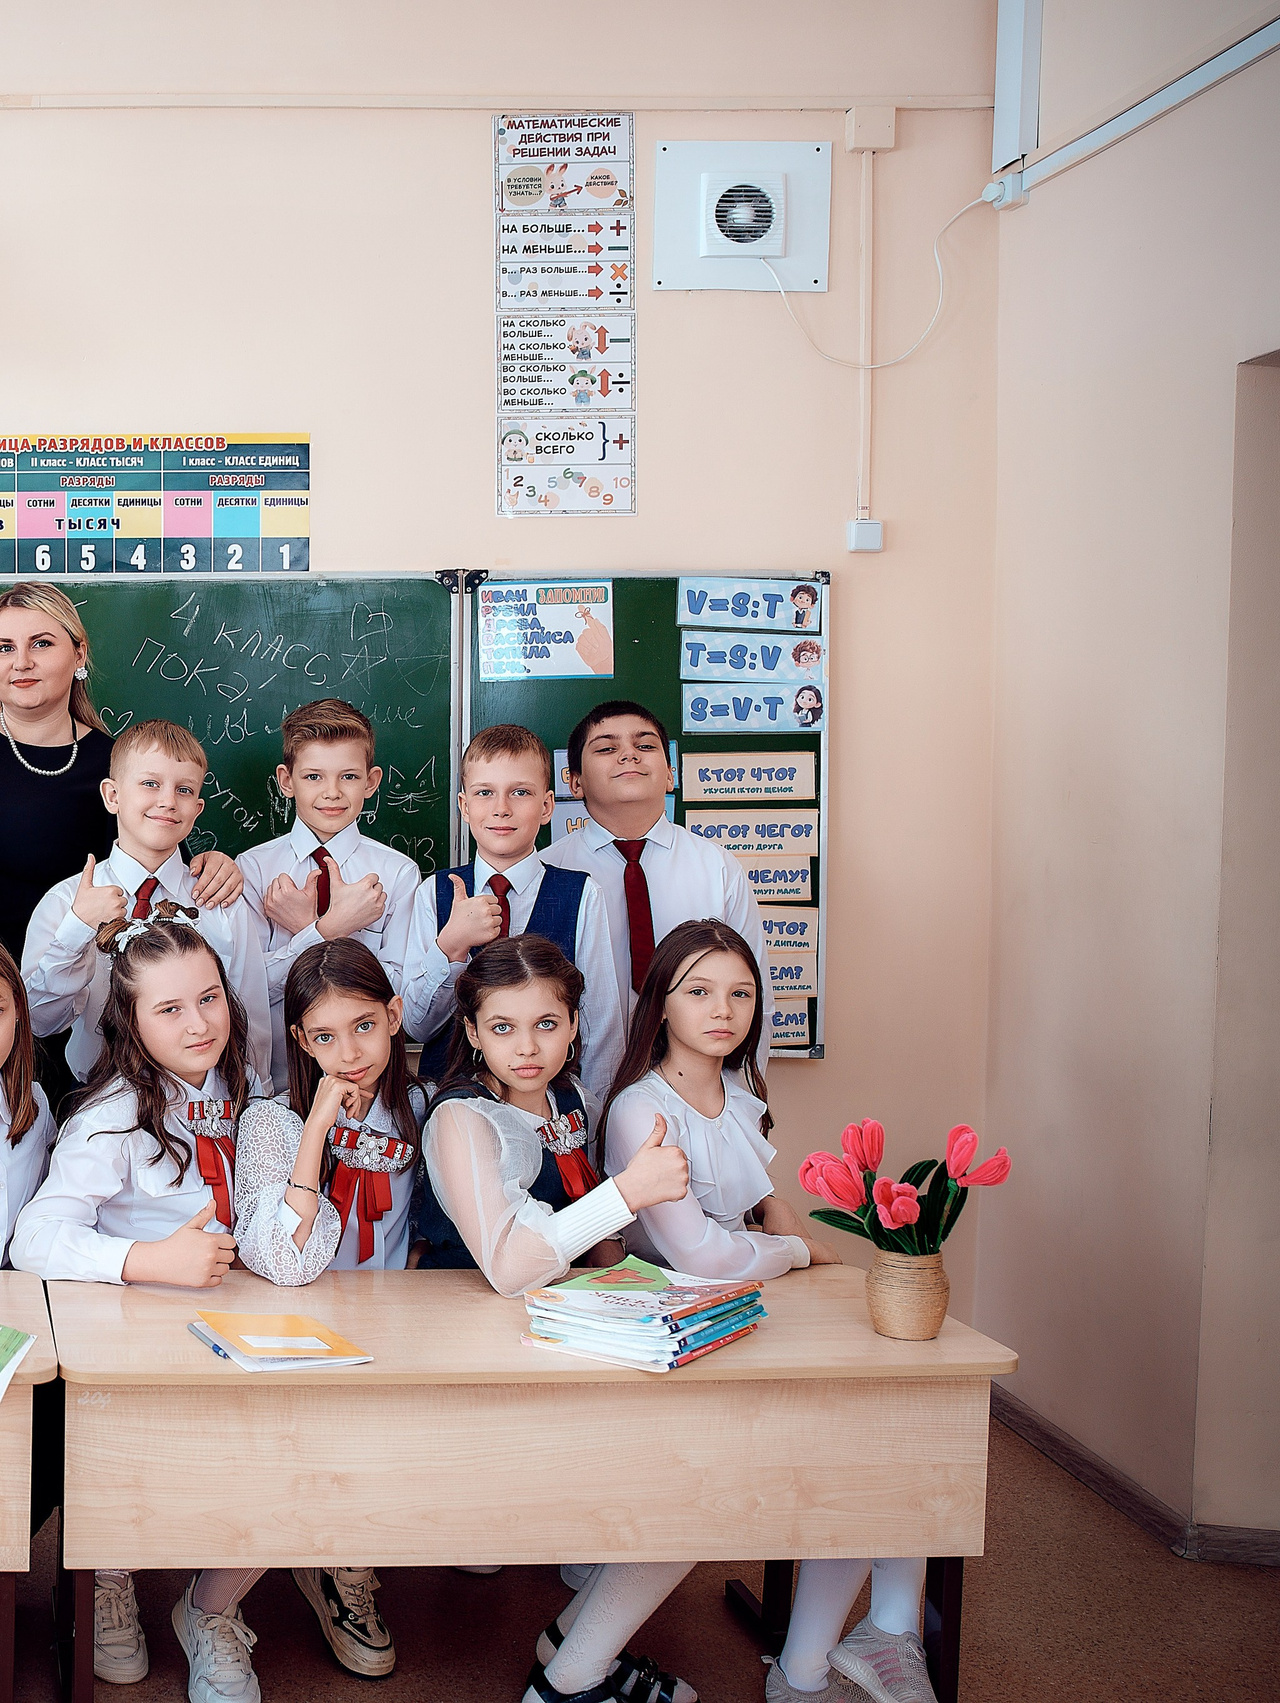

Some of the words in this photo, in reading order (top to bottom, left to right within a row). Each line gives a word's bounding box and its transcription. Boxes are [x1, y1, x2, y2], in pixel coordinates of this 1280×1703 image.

[506, 117, 622, 130] МАТЕМАТИЧЕСКИЕ
[518, 132, 583, 145] ДЕЙСТВИЯ
[586, 132, 610, 142] ПРИ
[512, 148, 571, 158] РЕШЕНИИ
[575, 146, 617, 157] ЗАДАЧ
[502, 224, 518, 233] НА
[522, 223, 585, 233] БОЛЬШЕ...
[502, 245, 518, 254] НА
[522, 244, 586, 254] МЕНЬШЕ...
[540, 266, 587, 274] БОЛЬШЕ...
[520, 290, 538, 298] РАЗ
[540, 290, 588, 298] МЕНЬШЕ...
[502, 320, 516, 328] НА
[519, 319, 566, 327] СКОЛЬКО
[502, 330, 553, 338] БОЛЬШЕ...
[502, 343, 516, 351] НА
[519, 342, 566, 351] СКОЛЬКО
[502, 353, 554, 361] МЕНЬШЕ...
[502, 365, 516, 373] ВО
[519, 364, 566, 372] СКОЛЬКО
[502, 375, 553, 383] БОЛЬШЕ...
[503, 388, 517, 396] ВО
[520, 387, 567, 395] СКОЛЬКО
[502, 398, 554, 406] МЕНЬШЕ...
[535, 432, 594, 441] СКОЛЬКО
[37, 437, 126, 452] РАЗРЯДОВ
[132, 437, 143, 449] И
[149, 437, 227, 450] КЛАССОВ
[535, 445, 575, 454] ВСЕГО
[31, 457, 38, 467] II
[40, 458, 67, 467] класс
[76, 457, 108, 467] КЛАСС
[110, 456, 144, 467] ТЫСЯЧ
[188, 458, 215, 466] класс
[225, 456, 257, 466] КЛАСС
[258, 456, 300, 467] ЕДИНИЦ
[60, 476, 115, 488] РАЗРЯДЫ
[209, 475, 265, 487] РАЗРЯДЫ
[513, 475, 524, 487] 2
[526, 485, 536, 497] 3
[538, 494, 549, 506] 4
[547, 476, 557, 488] 5
[563, 467, 574, 479] 6
[577, 476, 587, 488] 7
[588, 486, 601, 498] 8
[602, 493, 614, 506] 9
[613, 477, 630, 488] 10
[27, 499, 55, 508] СОТНИ
[71, 498, 110, 508] ДЕСЯТКИ
[117, 498, 161, 507] ЕДИНИЦЫ
[174, 498, 202, 506] СОТНИ
[217, 498, 257, 507] ДЕСЯТКИ
[264, 498, 309, 507] ЕДИНИЦЫ
[54, 518, 121, 530] ТЫСЯЧ
[35, 545, 51, 571] 6
[80, 545, 96, 571] 5
[130, 544, 147, 570] 4
[180, 544, 196, 570] 3
[227, 544, 243, 569] 2
[279, 544, 290, 569] 1
[481, 589, 527, 603] ИВАН
[538, 587, 605, 603] ЗАПОМНИ!
[170, 592, 200, 636] 4
[481, 603, 537, 617] РУБИЛ
[482, 631, 574, 645] ВАСИЛИСА
[698, 768, 746, 782] КТО?
[750, 767, 797, 781] ЧТО?
[764, 786, 794, 794] ЩЕНОК
[690, 824, 750, 839] КОГО?
[755, 823, 813, 838] ЧЕГО?
[755, 843, 784, 851] ДРУГА
[748, 869, 810, 884] ЧЕМУ?
[762, 920, 808, 935] ЧТО?
[773, 940, 810, 948] ДИПЛОМ
[772, 1031, 806, 1039] АНЕТАХ
